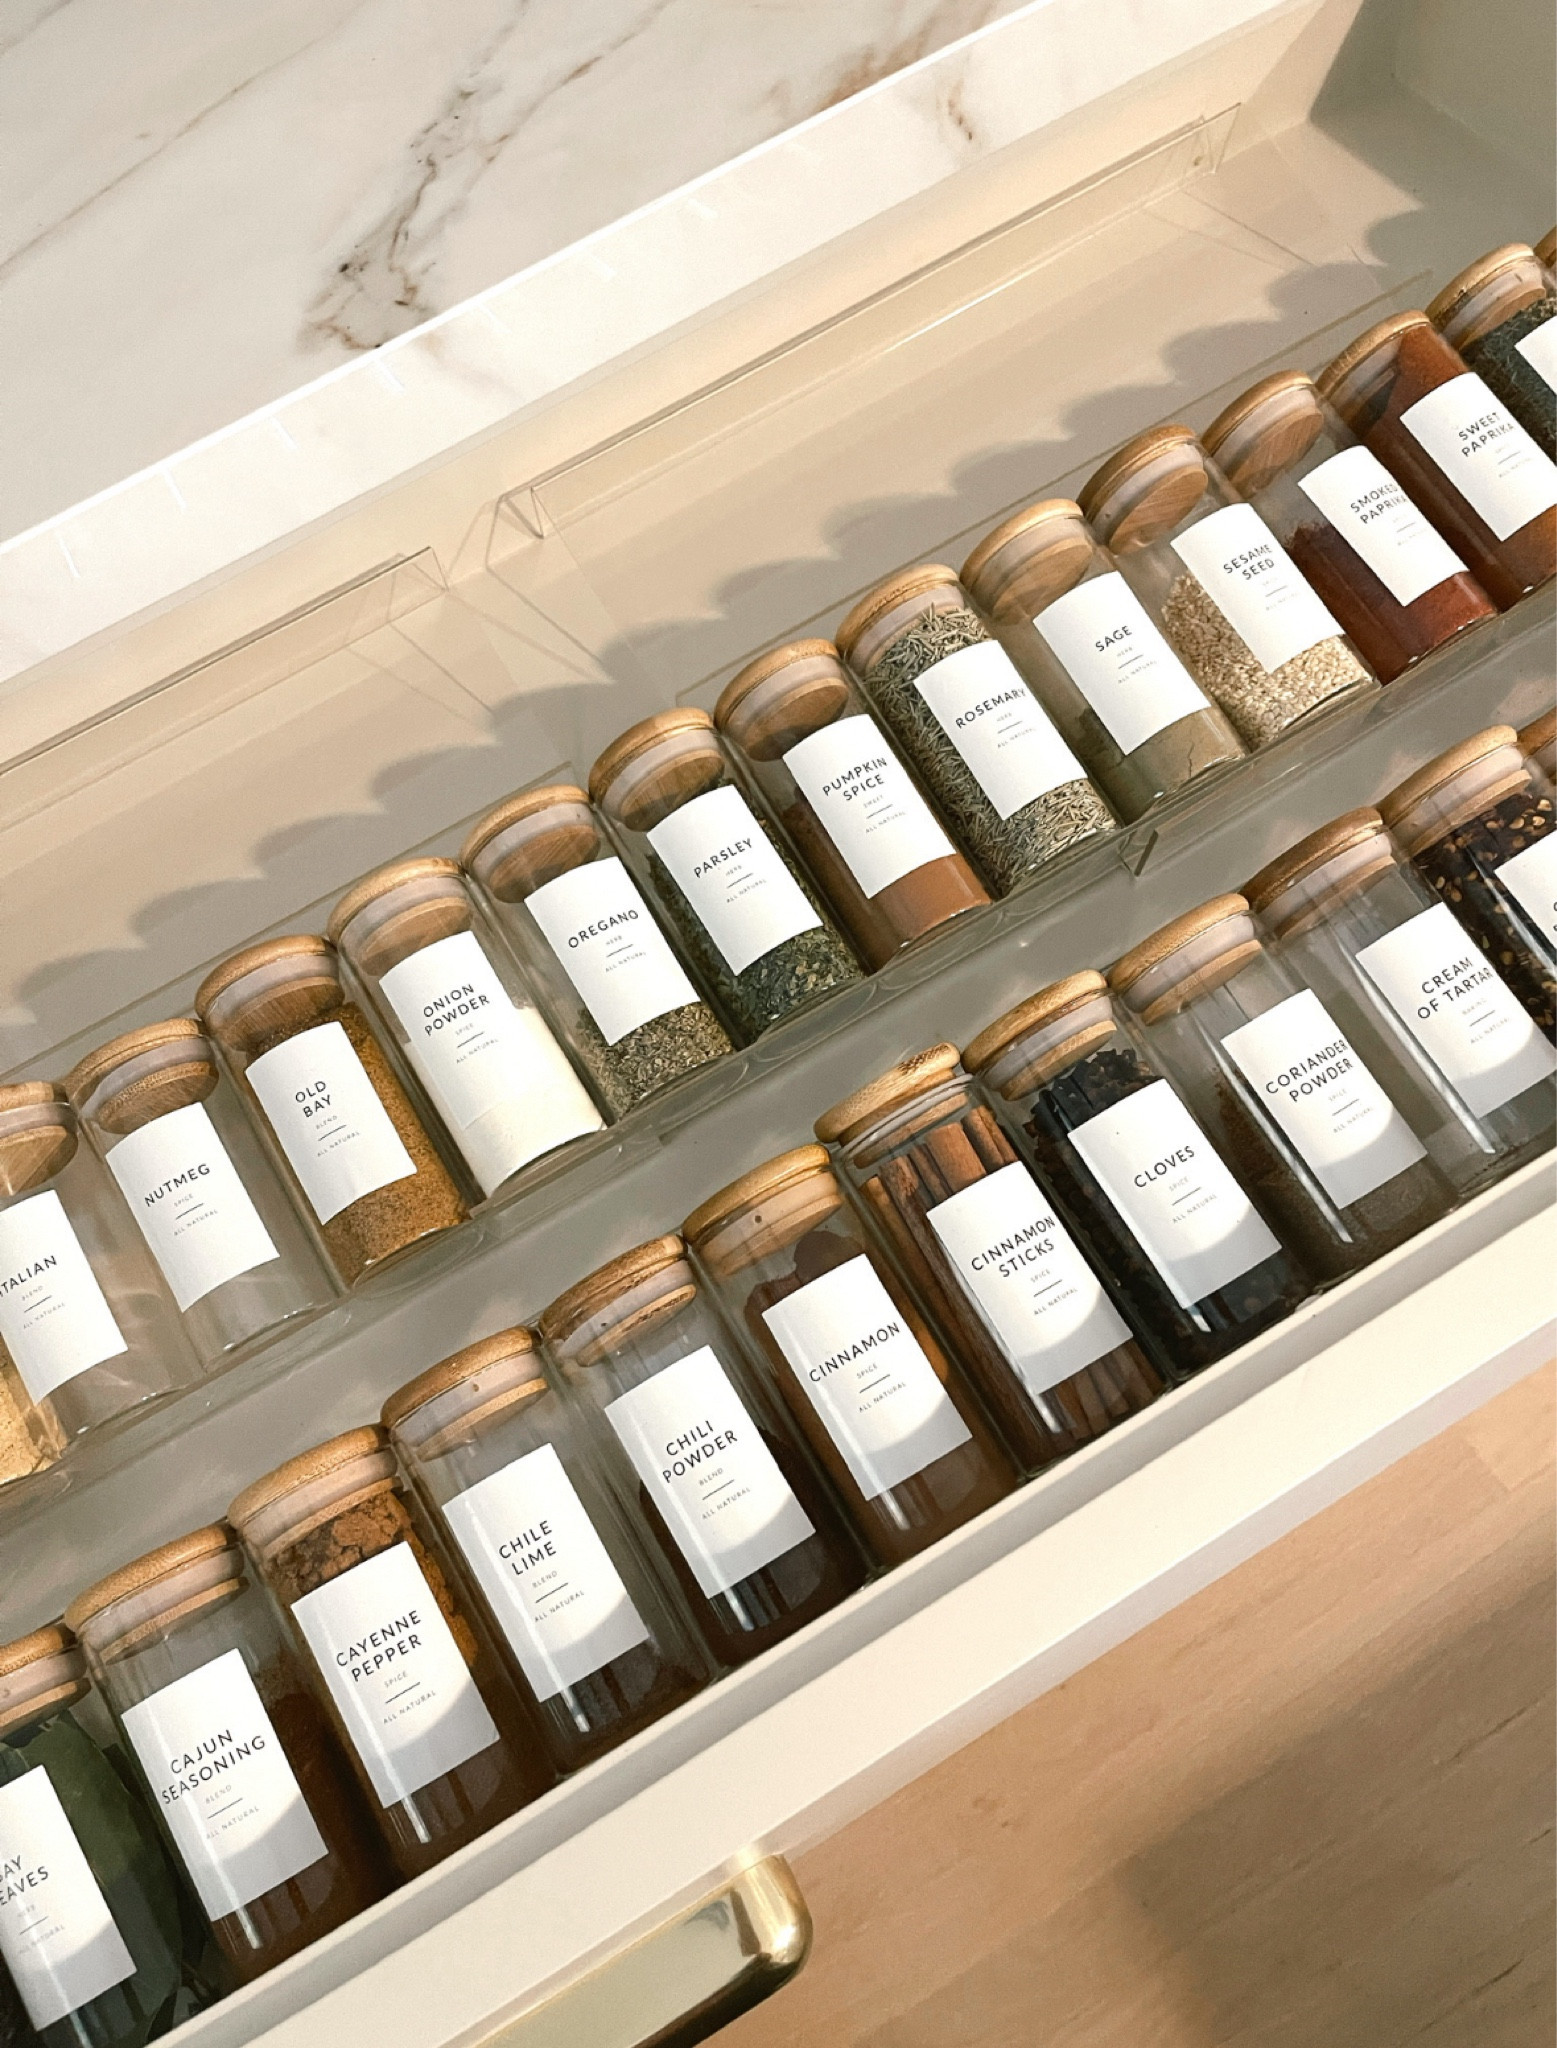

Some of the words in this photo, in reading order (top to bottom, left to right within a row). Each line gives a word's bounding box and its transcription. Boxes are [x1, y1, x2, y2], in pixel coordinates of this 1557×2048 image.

[1458, 412, 1501, 441] SWEET
[1462, 423, 1514, 457] PAPRIKA
[1350, 483, 1398, 513] SMOKED
[1359, 495, 1408, 524] PAPRIKA
[1223, 543, 1273, 574] SESAME
[1242, 559, 1275, 581] SEED
[1095, 625, 1133, 653] SAGE
[955, 688, 1027, 729] ROSEMARY
[823, 757, 889, 797] PUMPKIN
[843, 773, 885, 801] SPICE
[694, 837, 753, 878] PARSLEY
[568, 909, 639, 949] OREGANO
[1417, 999, 1440, 1019] OF
[1443, 967, 1494, 1001] TARTAR
[1421, 957, 1473, 994] CREAM
[423, 984, 475, 1018] ONION
[425, 994, 489, 1036] POWDER
[1265, 1040, 1348, 1095] CORIANDER
[1290, 1058, 1353, 1102] POWDER
[296, 1081, 327, 1103] OLD
[302, 1095, 333, 1118] BAY
[1134, 1145, 1196, 1188] CLOVES
[1169, 1175, 1189, 1191] SPICE
[145, 1163, 211, 1207] NUTMEG
[1172, 1212, 1187, 1224] ALL
[1187, 1193, 1217, 1213] NATURAL
[971, 1216, 1056, 1272] CINNAMON
[998, 1239, 1055, 1278] STICKS
[808, 1322, 900, 1382] CINNAMON
[856, 1363, 878, 1379] SPICE
[858, 1402, 872, 1413] ALL
[872, 1381, 906, 1403] NATURAL
[665, 1420, 714, 1457] CHILI
[662, 1430, 738, 1483] POWDER
[697, 1467, 723, 1485] BLEND
[701, 1508, 717, 1520] ALL
[717, 1486, 750, 1508] NATURAL
[498, 1520, 552, 1560] CHILE
[511, 1541, 557, 1575] LIME
[532, 1570, 558, 1588] BLEND
[534, 1612, 548, 1623] ALL
[548, 1590, 585, 1613] NATURAL
[336, 1610, 421, 1667] CAYENNE
[351, 1634, 421, 1682] PEPPER
[384, 1671, 408, 1688] SPICE
[383, 1712, 399, 1724] ALL
[399, 1689, 436, 1714] NATURAL
[170, 1729, 233, 1775] CAJUN
[161, 1735, 265, 1805] SEASONING
[205, 1784, 231, 1805] BLEND
[205, 1828, 220, 1840] ALL
[220, 1805, 260, 1830] NATURAL
[0, 1866, 48, 1906] EAVES
